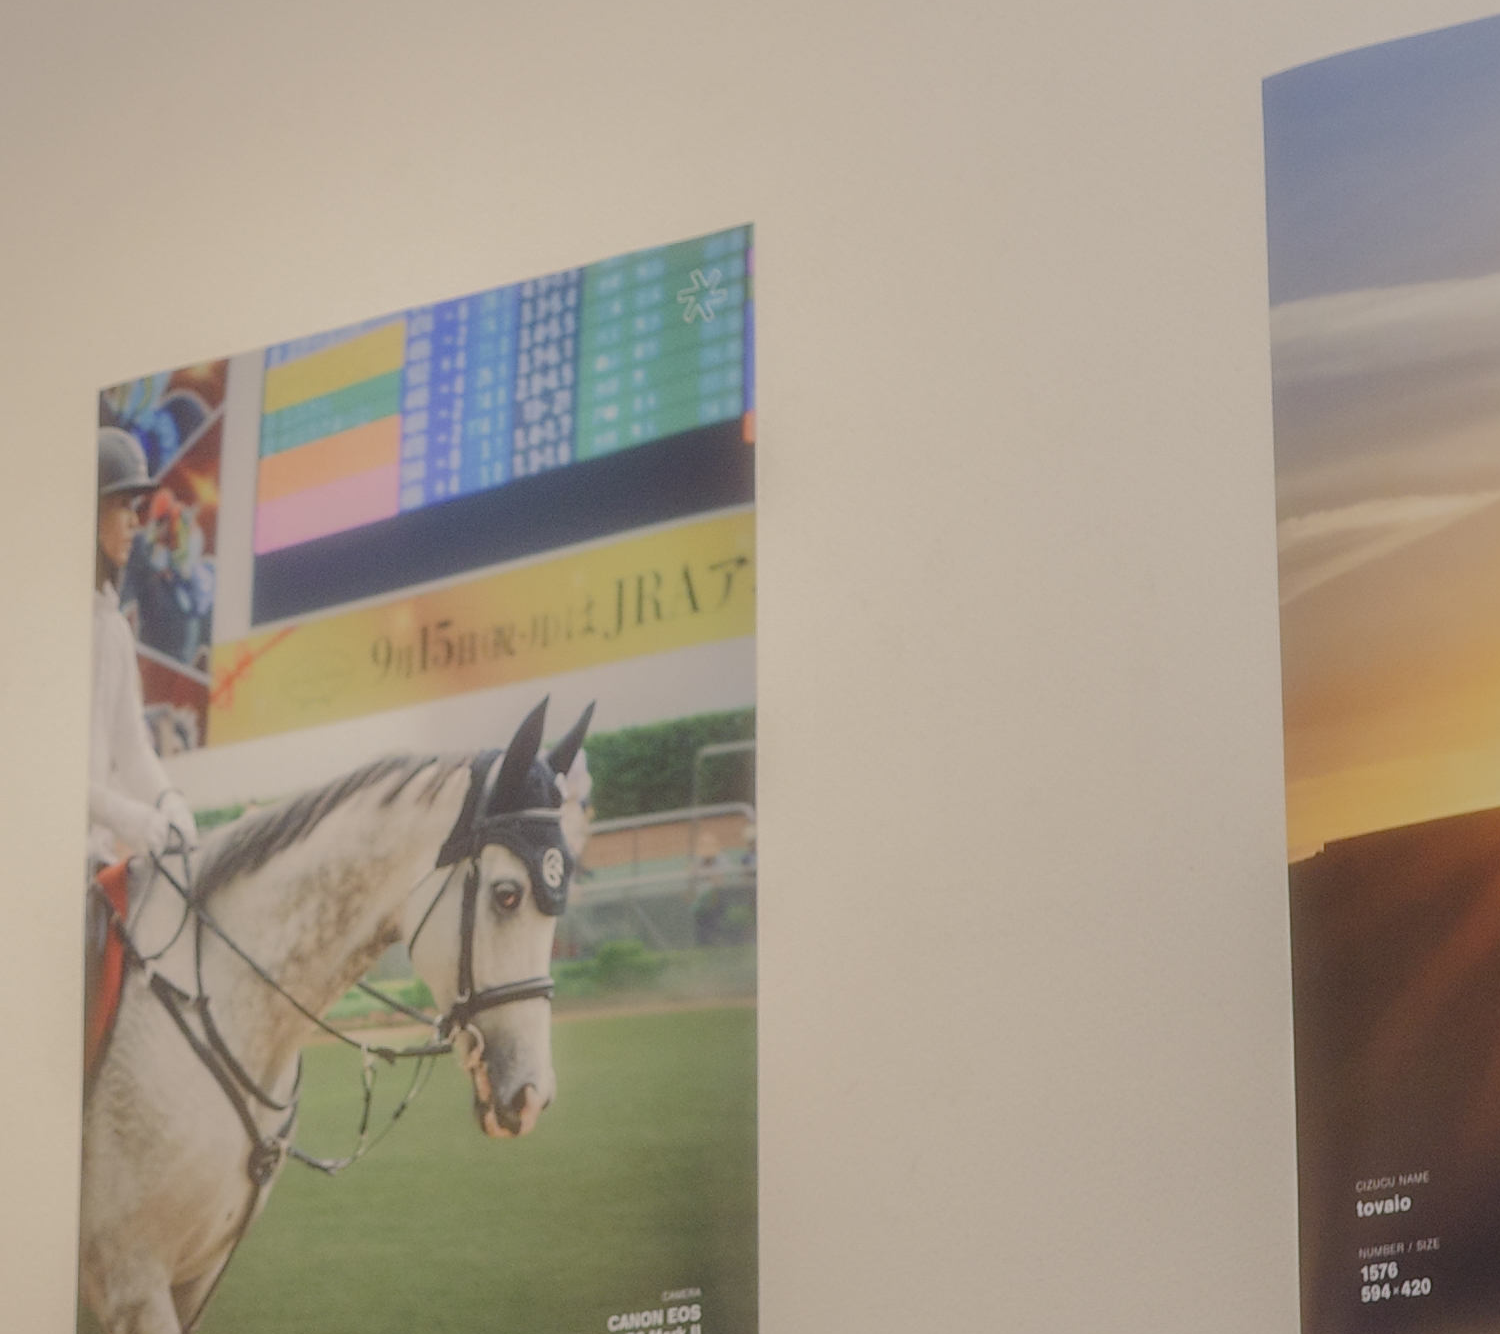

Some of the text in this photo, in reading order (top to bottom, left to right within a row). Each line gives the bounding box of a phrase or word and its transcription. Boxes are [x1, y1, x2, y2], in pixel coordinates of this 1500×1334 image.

[1398, 1170, 1430, 1186] NAME
[1358, 1241, 1405, 1260] NUMBER
[1416, 1237, 1441, 1253] SIZE
[1360, 1261, 1399, 1283] 1576
[607, 1304, 702, 1333] CANON EOS
